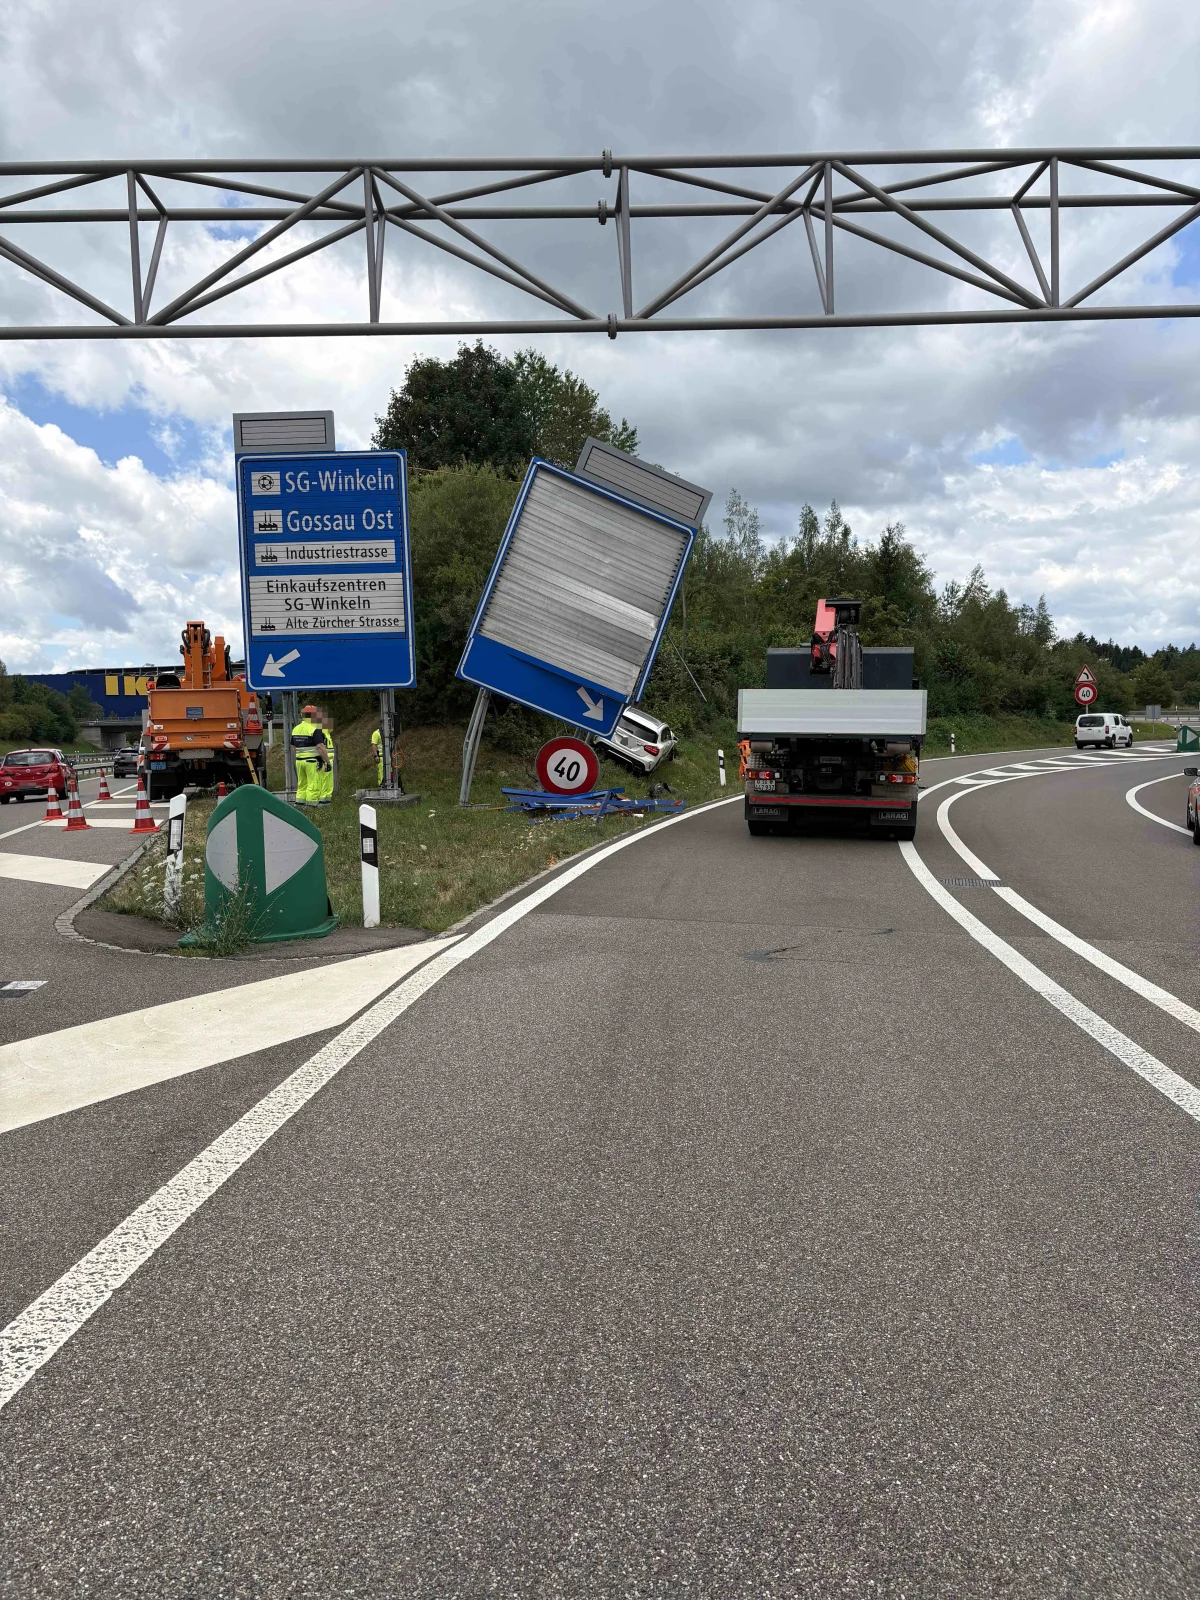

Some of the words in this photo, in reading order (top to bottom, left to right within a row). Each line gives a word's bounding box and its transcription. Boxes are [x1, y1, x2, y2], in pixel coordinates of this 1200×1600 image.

[285, 468, 395, 493] SG-Winkeln
[286, 510, 355, 532] Gossau
[362, 508, 394, 530] Ost
[286, 545, 388, 560] Industriestrasse
[266, 578, 386, 593] Einkaufszentren
[284, 595, 371, 611] SG-Winkeln
[286, 617, 309, 629] Alte
[312, 616, 355, 629] Zürcher
[359, 616, 400, 628] Strasse
[105, 675, 158, 696] IK
[1081, 689, 1091, 698] 40
[553, 756, 580, 782] 40
